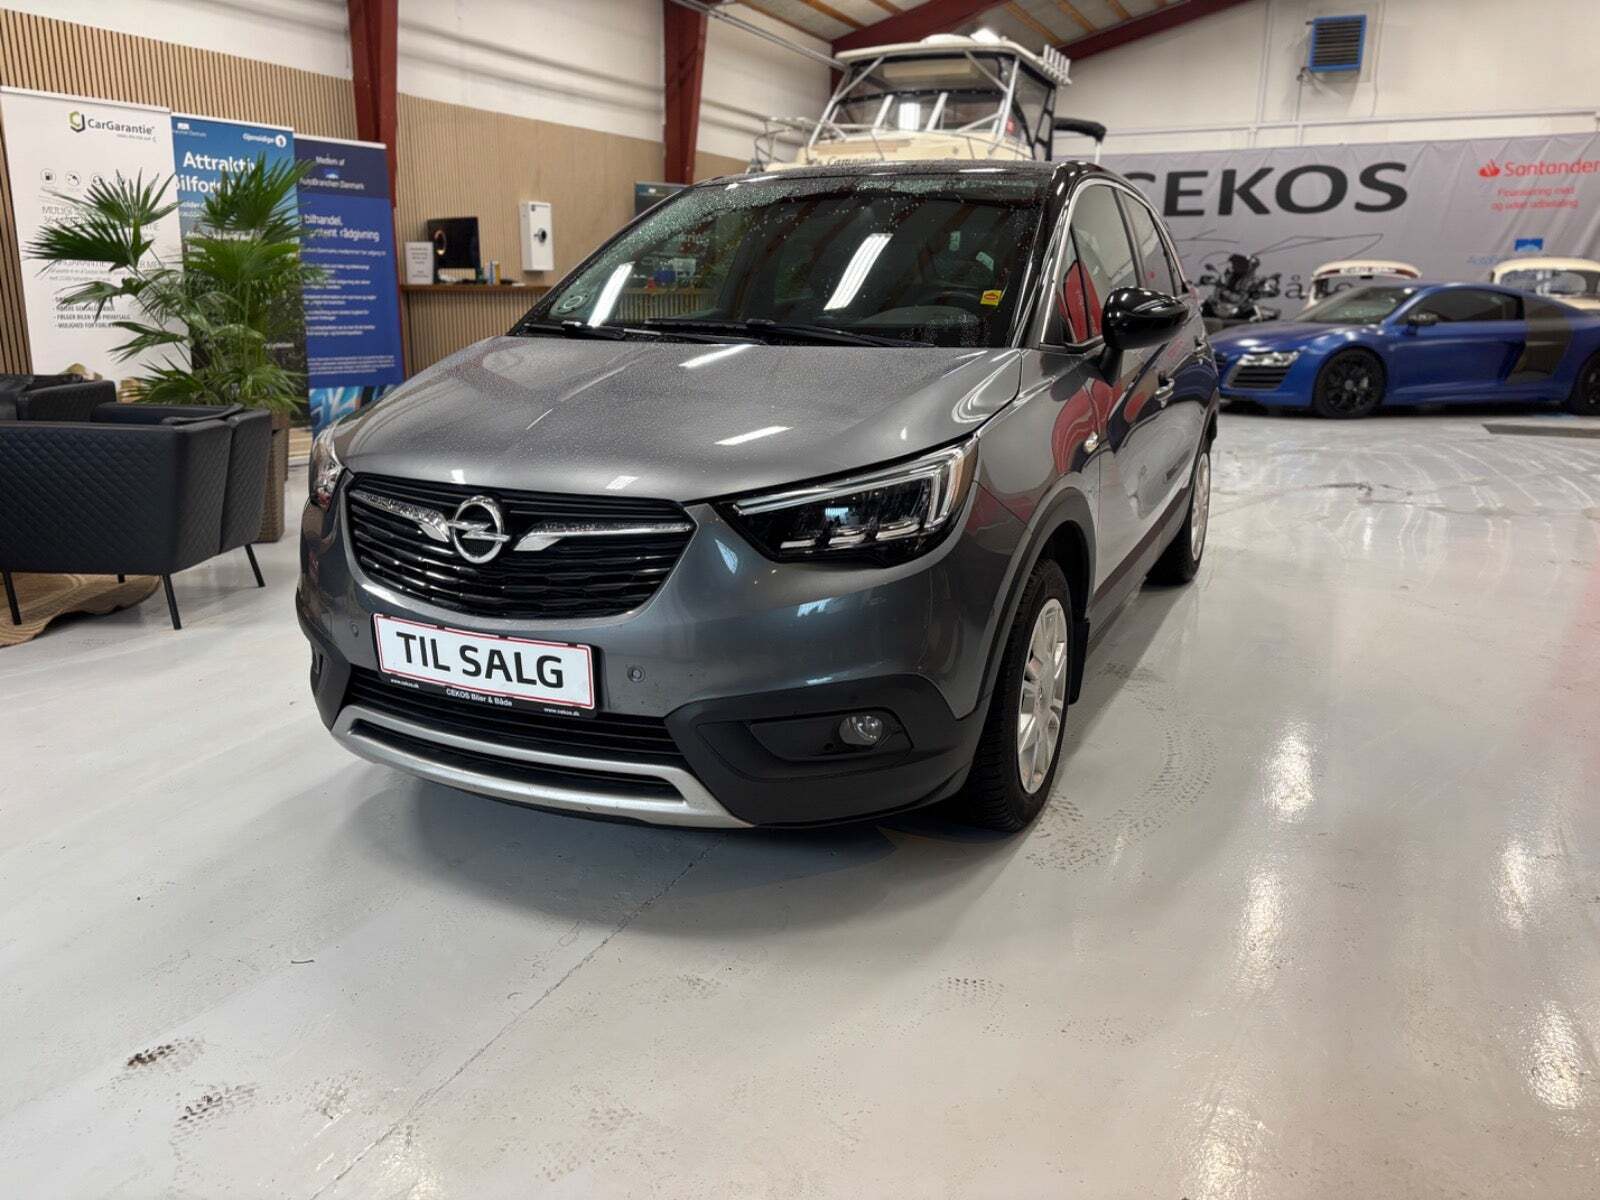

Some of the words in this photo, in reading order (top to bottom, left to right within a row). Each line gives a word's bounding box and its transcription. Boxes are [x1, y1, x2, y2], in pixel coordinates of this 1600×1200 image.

[87, 118, 153, 135] CarGarantie
[396, 631, 450, 672] TIL
[459, 644, 563, 688] SALG
[446, 688, 470, 700] CEKOS
[471, 692, 486, 703] Biler
